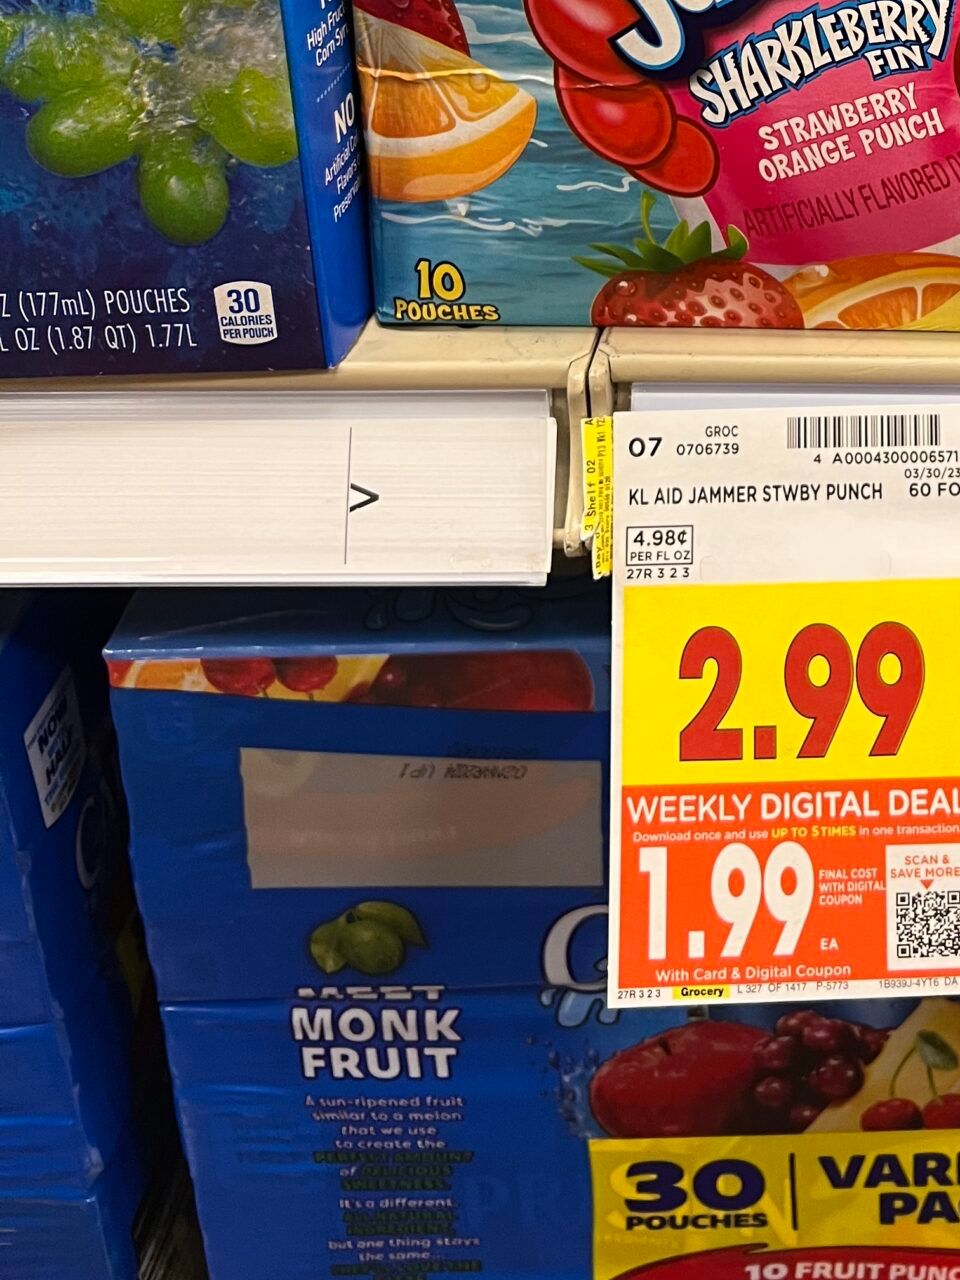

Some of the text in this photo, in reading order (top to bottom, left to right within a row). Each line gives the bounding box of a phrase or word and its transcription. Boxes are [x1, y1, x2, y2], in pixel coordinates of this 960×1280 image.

[306, 23, 327, 50] High
[868, 43, 924, 76] FIN
[758, 82, 918, 150] STRAWBERRY
[758, 108, 944, 182] ORANGE PUNCH
[859, 160, 950, 214] FLAVORED
[416, 261, 465, 299] 10
[18, 287, 191, 322] (177mL) POUCHES
[226, 290, 259, 314] 30
[395, 298, 498, 320] POUCHES
[220, 313, 273, 327] CALORIES
[14, 325, 137, 354] OZ QT)
[243, 326, 275, 339] POUCH
[705, 425, 739, 438] GROC
[629, 437, 739, 458] 07 0706739
[832, 451, 959, 465] A0004300006571
[587, 481, 597, 517] Shelf
[629, 483, 883, 506] KL AID JAMMER STWBY PUNCH
[633, 531, 688, 548] 4.98¢
[679, 621, 926, 762] 2.99
[626, 793, 752, 823] WEEKLY
[760, 790, 879, 820] DIGITAL
[633, 830, 691, 843] Download
[904, 855, 940, 866] SCAN
[819, 868, 877, 880] FINAL COST
[890, 867, 921, 878] SAVE
[819, 882, 845, 893] WITH
[639, 841, 814, 960] 1.99
[819, 894, 863, 905] COUPON
[655, 964, 852, 982] With Card Digital Coupon
[681, 986, 724, 998] Grocery
[292, 1008, 462, 1041] MONK
[302, 1047, 457, 1078] FRUIT
[625, 1159, 766, 1215] 30
[626, 1213, 767, 1230] POUCHES
